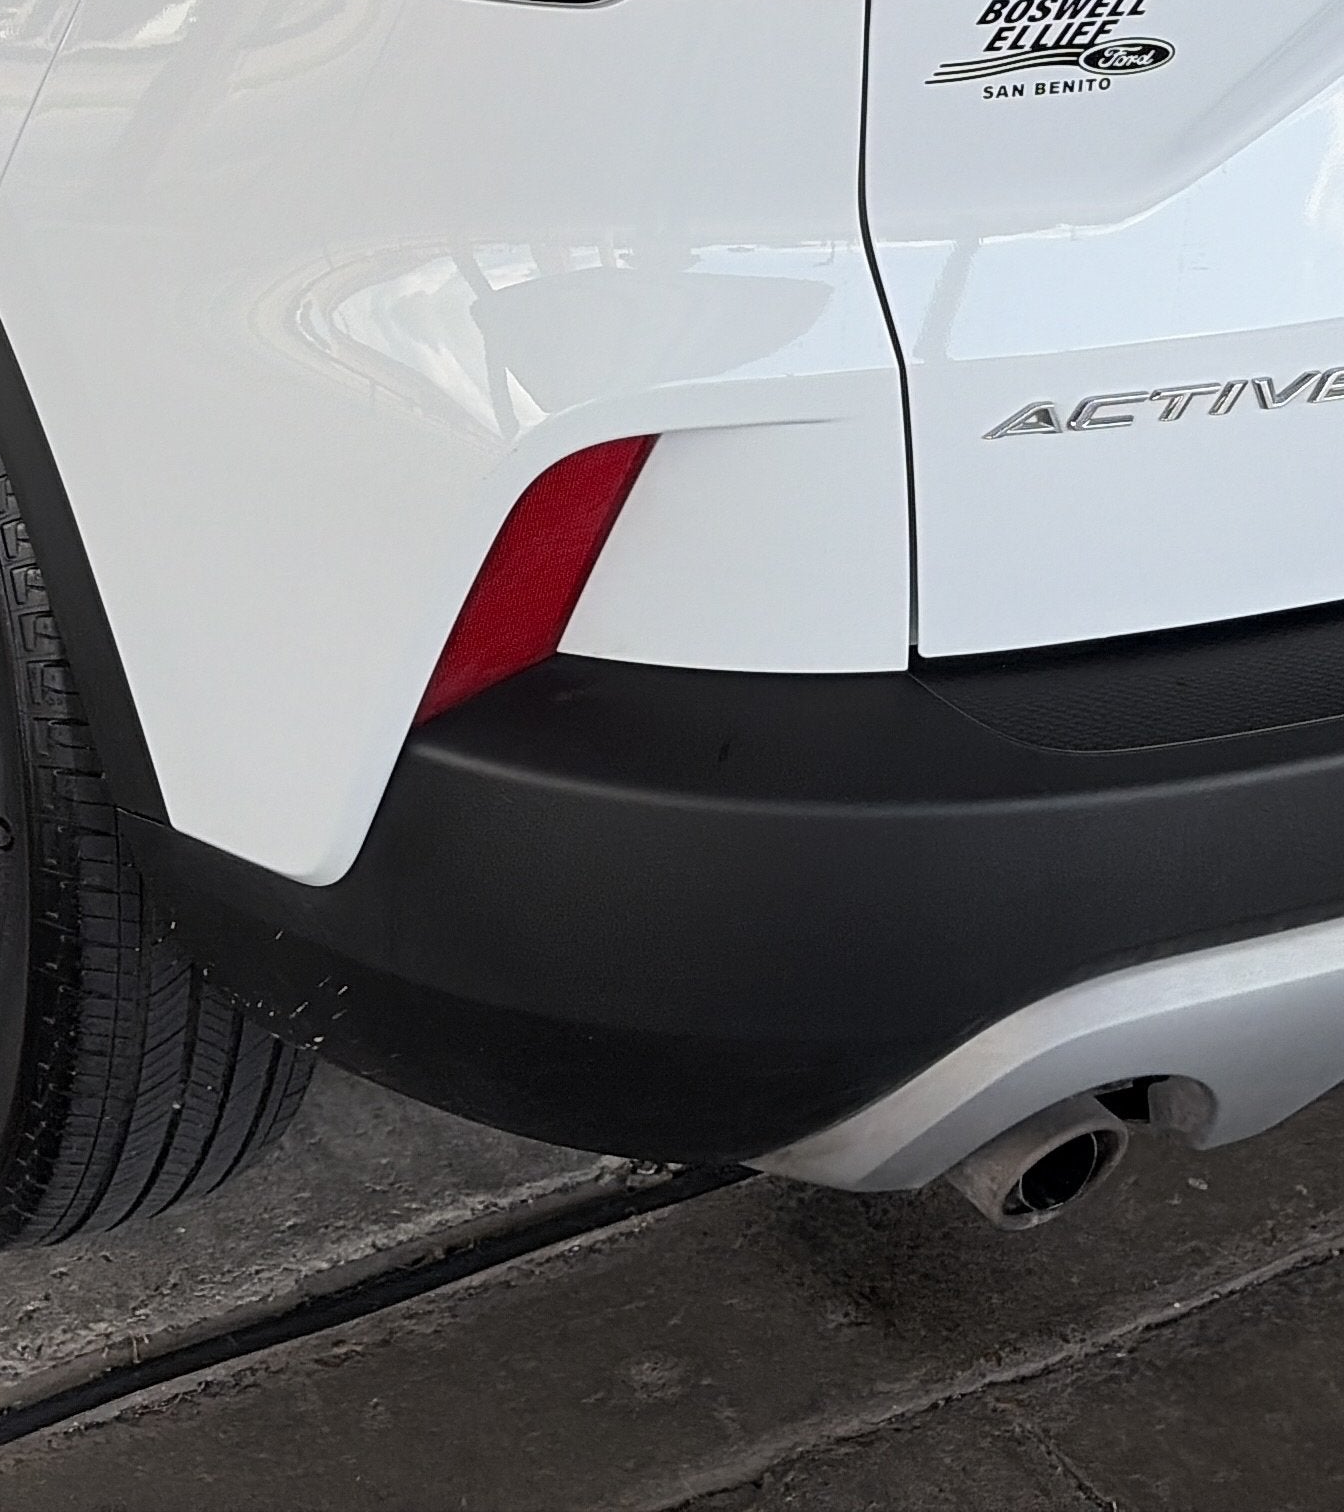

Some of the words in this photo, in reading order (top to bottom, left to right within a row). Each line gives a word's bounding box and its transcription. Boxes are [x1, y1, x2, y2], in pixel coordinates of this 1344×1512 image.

[983, 19, 1122, 53] ELLIFF
[1098, 45, 1154, 69] Ford
[982, 83, 1025, 100] SAN
[1034, 77, 1112, 96] BENITO
